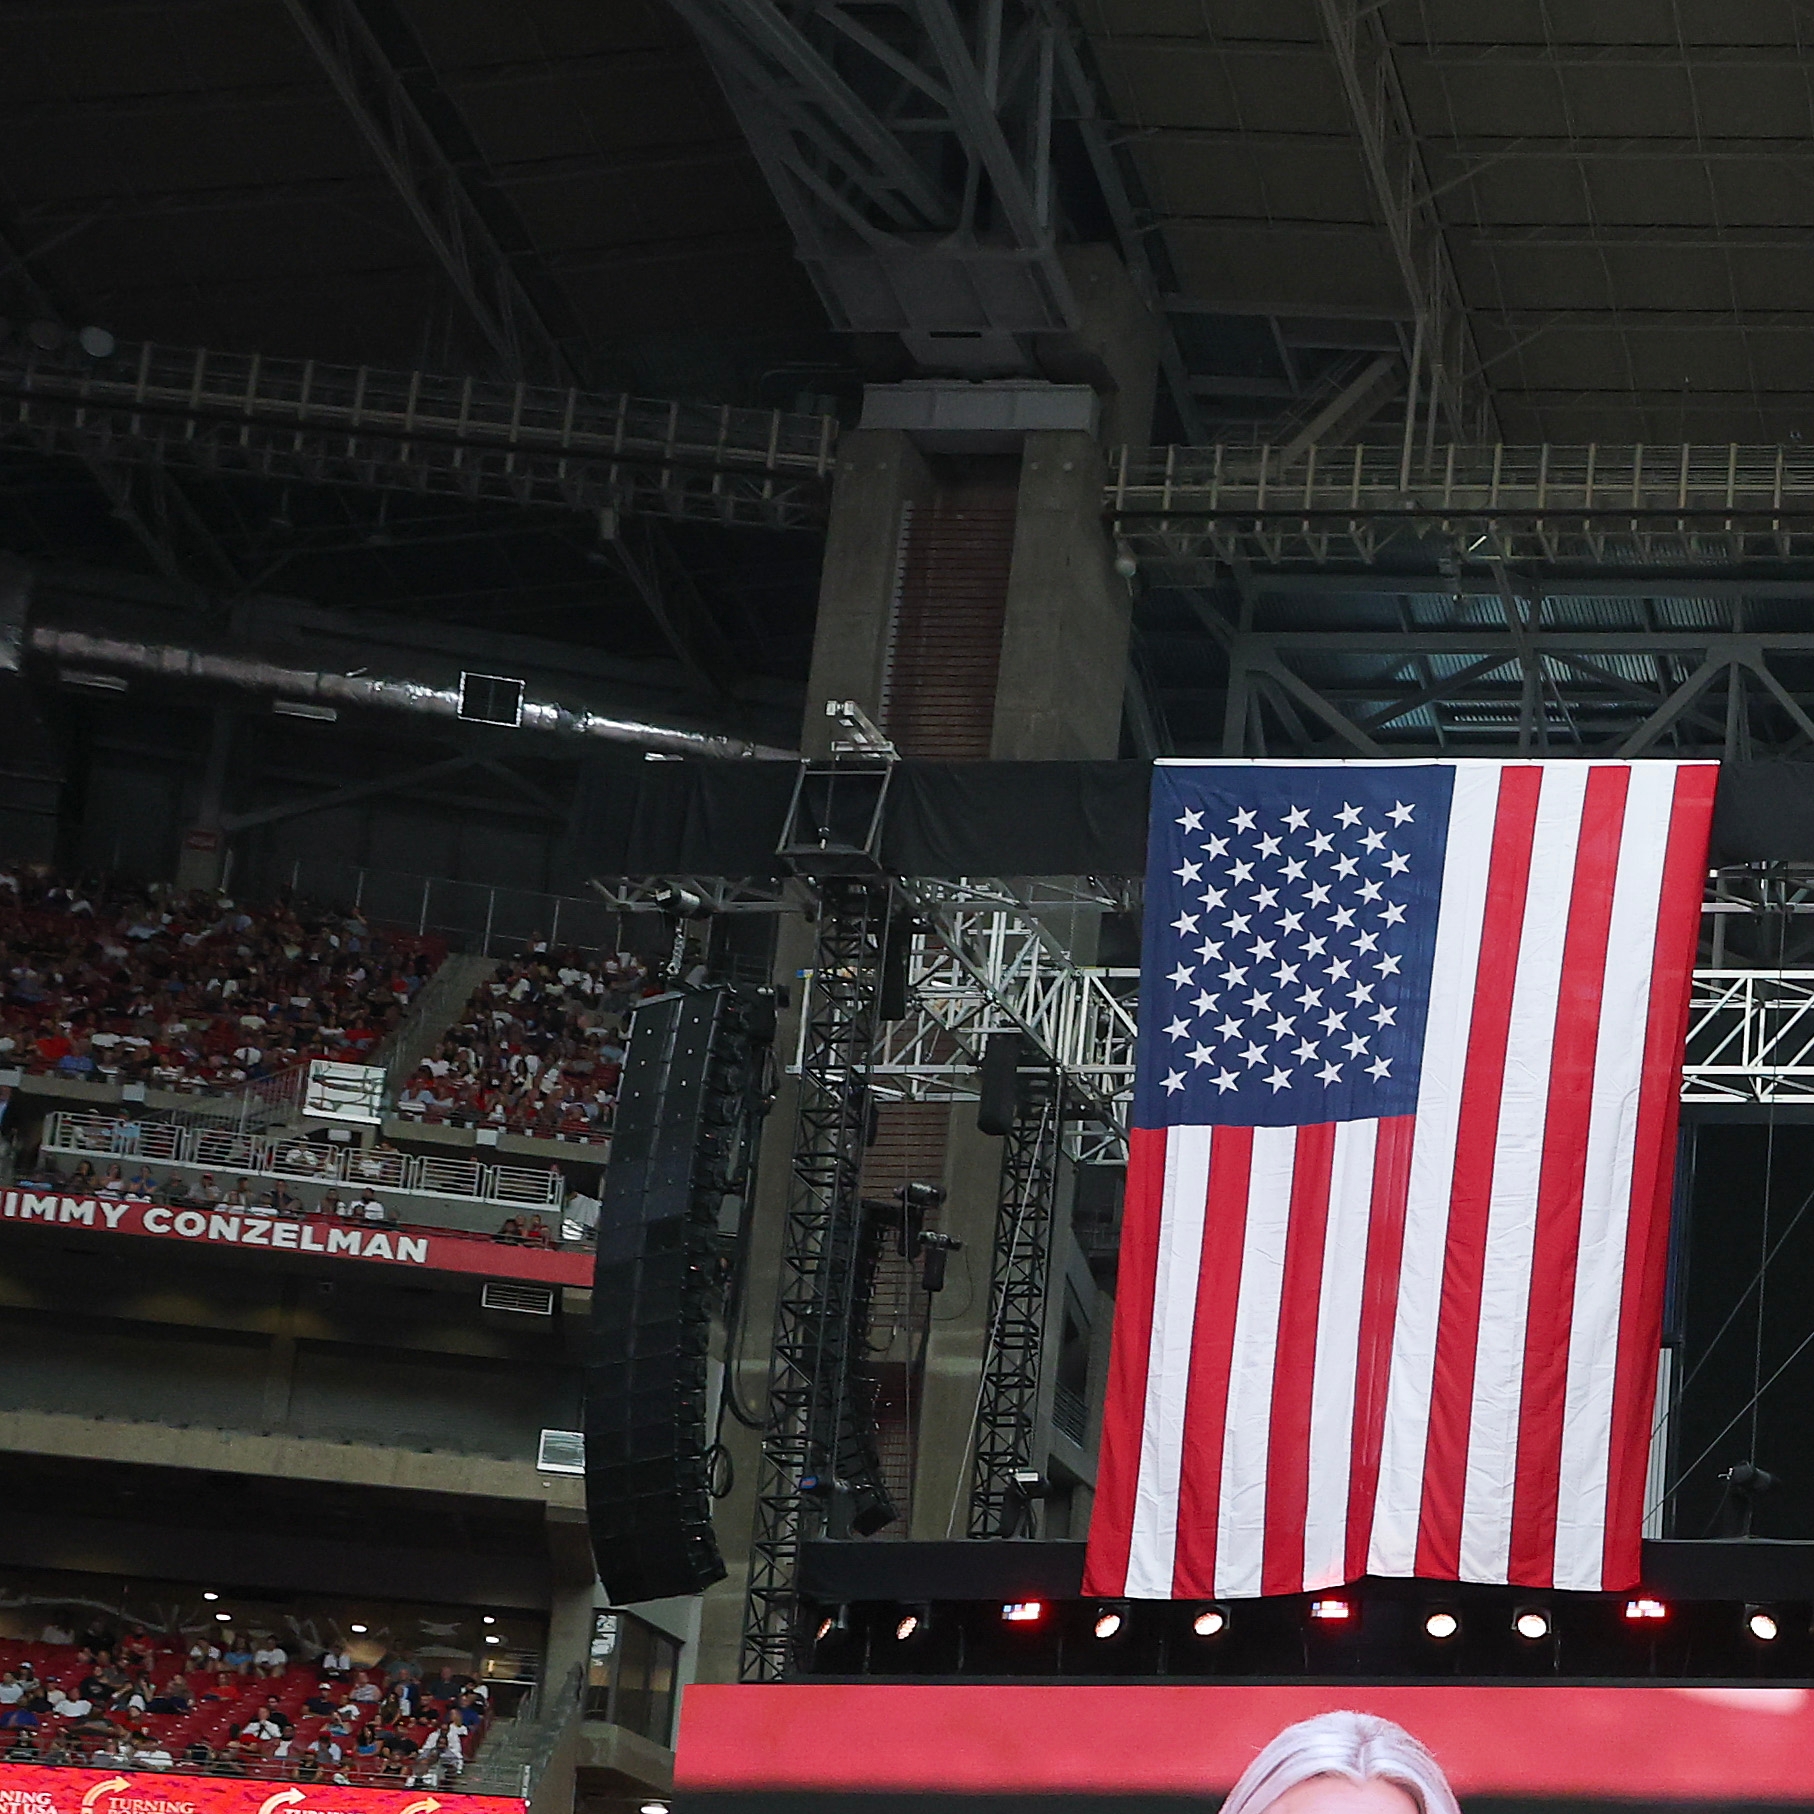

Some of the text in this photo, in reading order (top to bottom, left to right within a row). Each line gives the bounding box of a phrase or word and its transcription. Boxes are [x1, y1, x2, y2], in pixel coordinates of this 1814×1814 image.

[0, 1190, 429, 1264] IMMY CONZELMAN
[108, 1797, 195, 1814] TURNING
